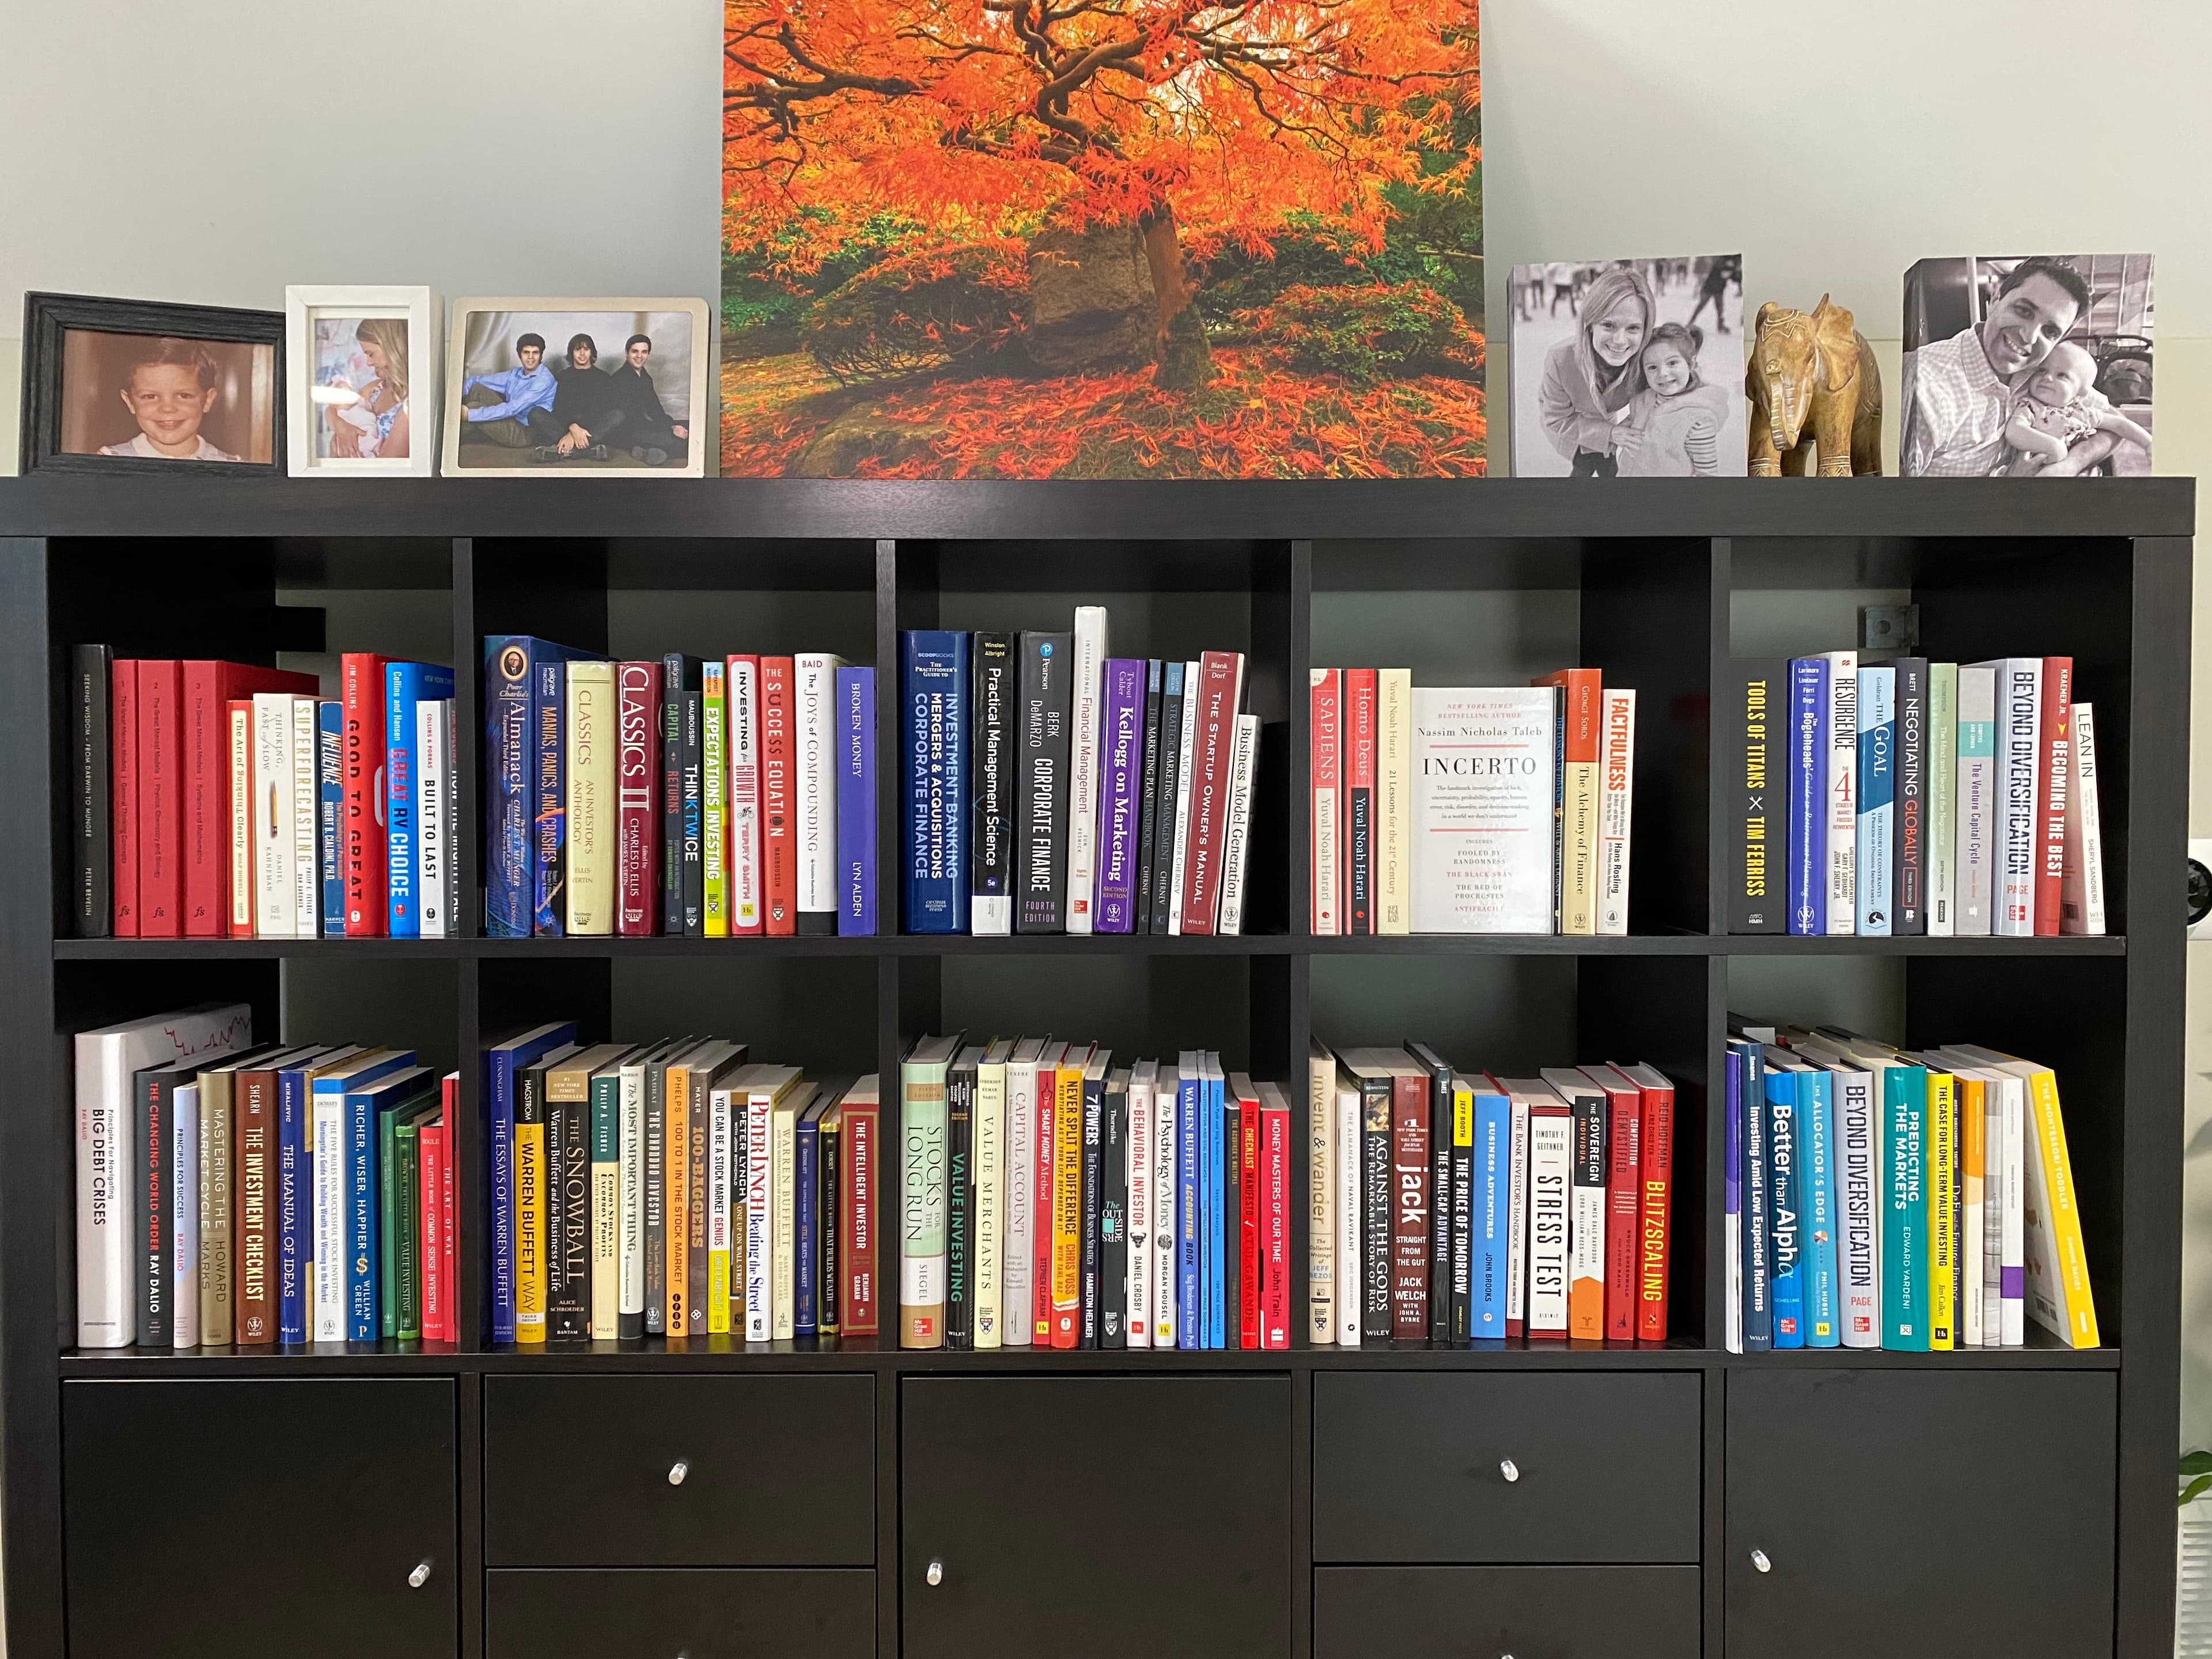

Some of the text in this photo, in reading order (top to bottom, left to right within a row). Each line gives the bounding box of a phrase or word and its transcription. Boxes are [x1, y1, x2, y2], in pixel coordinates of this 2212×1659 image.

[510, 702, 526, 794] Almanack
[578, 691, 592, 765] CLASSICS
[620, 666, 649, 812] CLASSICS II
[739, 671, 748, 750] INVESTING
[851, 683, 861, 778] BROKEN MONEY
[1047, 711, 1059, 737] BERK
[1210, 692, 1221, 718] THE
[1320, 697, 1334, 779] SAPIENS
[1418, 727, 1542, 737] Nassim Nicholas Taleb
[1608, 698, 1629, 791] FACTFULNESS
[1747, 680, 1766, 788] TOOLS OF TITANS
[1835, 678, 1855, 750] RESURGENCE
[2078, 713, 2093, 778] LEAN IN
[85, 796, 91, 806] TO
[296, 707, 312, 862] SUPERFORECASTING
[324, 802, 334, 825] ROBERT
[685, 764, 698, 861] THINK TWICE
[706, 707, 719, 880] EXPECTATIONS INVESTING
[915, 692, 927, 879] CORPORATE FINANCE
[931, 692, 942, 879] MERGERS & ACQUISITIONS
[946, 692, 957, 878] INVESTMENT BANKING
[984, 668, 1001, 866] Practical Management Science
[1108, 707, 1133, 881] Kellogg on Marketing
[1226, 727, 1252, 898] Business Model Generation
[1423, 757, 1536, 775] INCERTO
[1904, 698, 1918, 864] NEGOTIATING GLOBALLY
[1969, 763, 1982, 864] The Venture Capital Cycle
[2047, 740, 2067, 878] BECOMING THE BEST
[324, 835, 335, 865] CIALDINI,
[325, 866, 335, 882] PH.D.
[391, 833, 408, 896] CHOICE
[425, 780, 435, 879] BUILT TO LAST
[1031, 758, 1053, 892] CORPORATE FINANCE
[1194, 850, 1207, 904] MANUAL
[1355, 797, 1366, 900] Yuval Noah Harari
[1575, 767, 1589, 895] The Alchemy of Finance
[1611, 865, 1622, 893] Rosling
[1613, 843, 1623, 862] Hans
[1747, 816, 1765, 896] TIM FERRISS
[853, 862, 861, 916] LYN ALDEN
[524, 1080, 532, 1120] HAGSTROM
[92, 1109, 105, 1225] BIG DEBT CRISES
[692, 1126, 704, 1248] 100-BAGGERS
[747, 1101, 769, 1313] PETER LYNCH Beating the Street
[855, 1121, 866, 1249] THE INTELLIGENT INVESTOR
[907, 1126, 923, 1241] LONG RUN
[926, 1127, 942, 1206] STOCKS
[982, 1116, 994, 1290] VALUE MERCHANTS
[1065, 1081, 1077, 1235] NEVER SPLIT THE DIFFERENCE
[1396, 1164, 1428, 1224] jack
[1486, 1122, 1496, 1239] BUSINESS ADVENTURES
[1749, 1106, 1765, 1312] Investing Amid Low Expected Returns
[1813, 1100, 1825, 1223] ALLOCATOR'S EDGE
[1895, 1103, 1907, 1210] THE MARKETS
[1907, 1111, 1919, 1202] PREDICTING
[1938, 1086, 1948, 1267] THE CASE FOR LONG-TERM VALUE INVESTING
[245, 1127, 263, 1301] THE INVESTMENT CHECKLIST
[283, 1145, 294, 1297] THE MANUAL OF IDEAS
[522, 1142, 535, 1312] WARREN BUFFETT WAY
[566, 1147, 585, 1284] SNOWBALL
[950, 1153, 965, 1302] VALUE INVESTING
[1376, 1135, 1388, 1311] AGAINST THE GODS
[1455, 1158, 1468, 1294] THE PRICE OF TOMORROW
[1536, 1176, 1562, 1297] STRESS TEST
[1643, 1181, 1666, 1301] BLITZSCALING
[1902, 1226, 1911, 1309] EDWARD YARDENI
[1484, 1252, 1493, 1302] JOHN BROOKS
